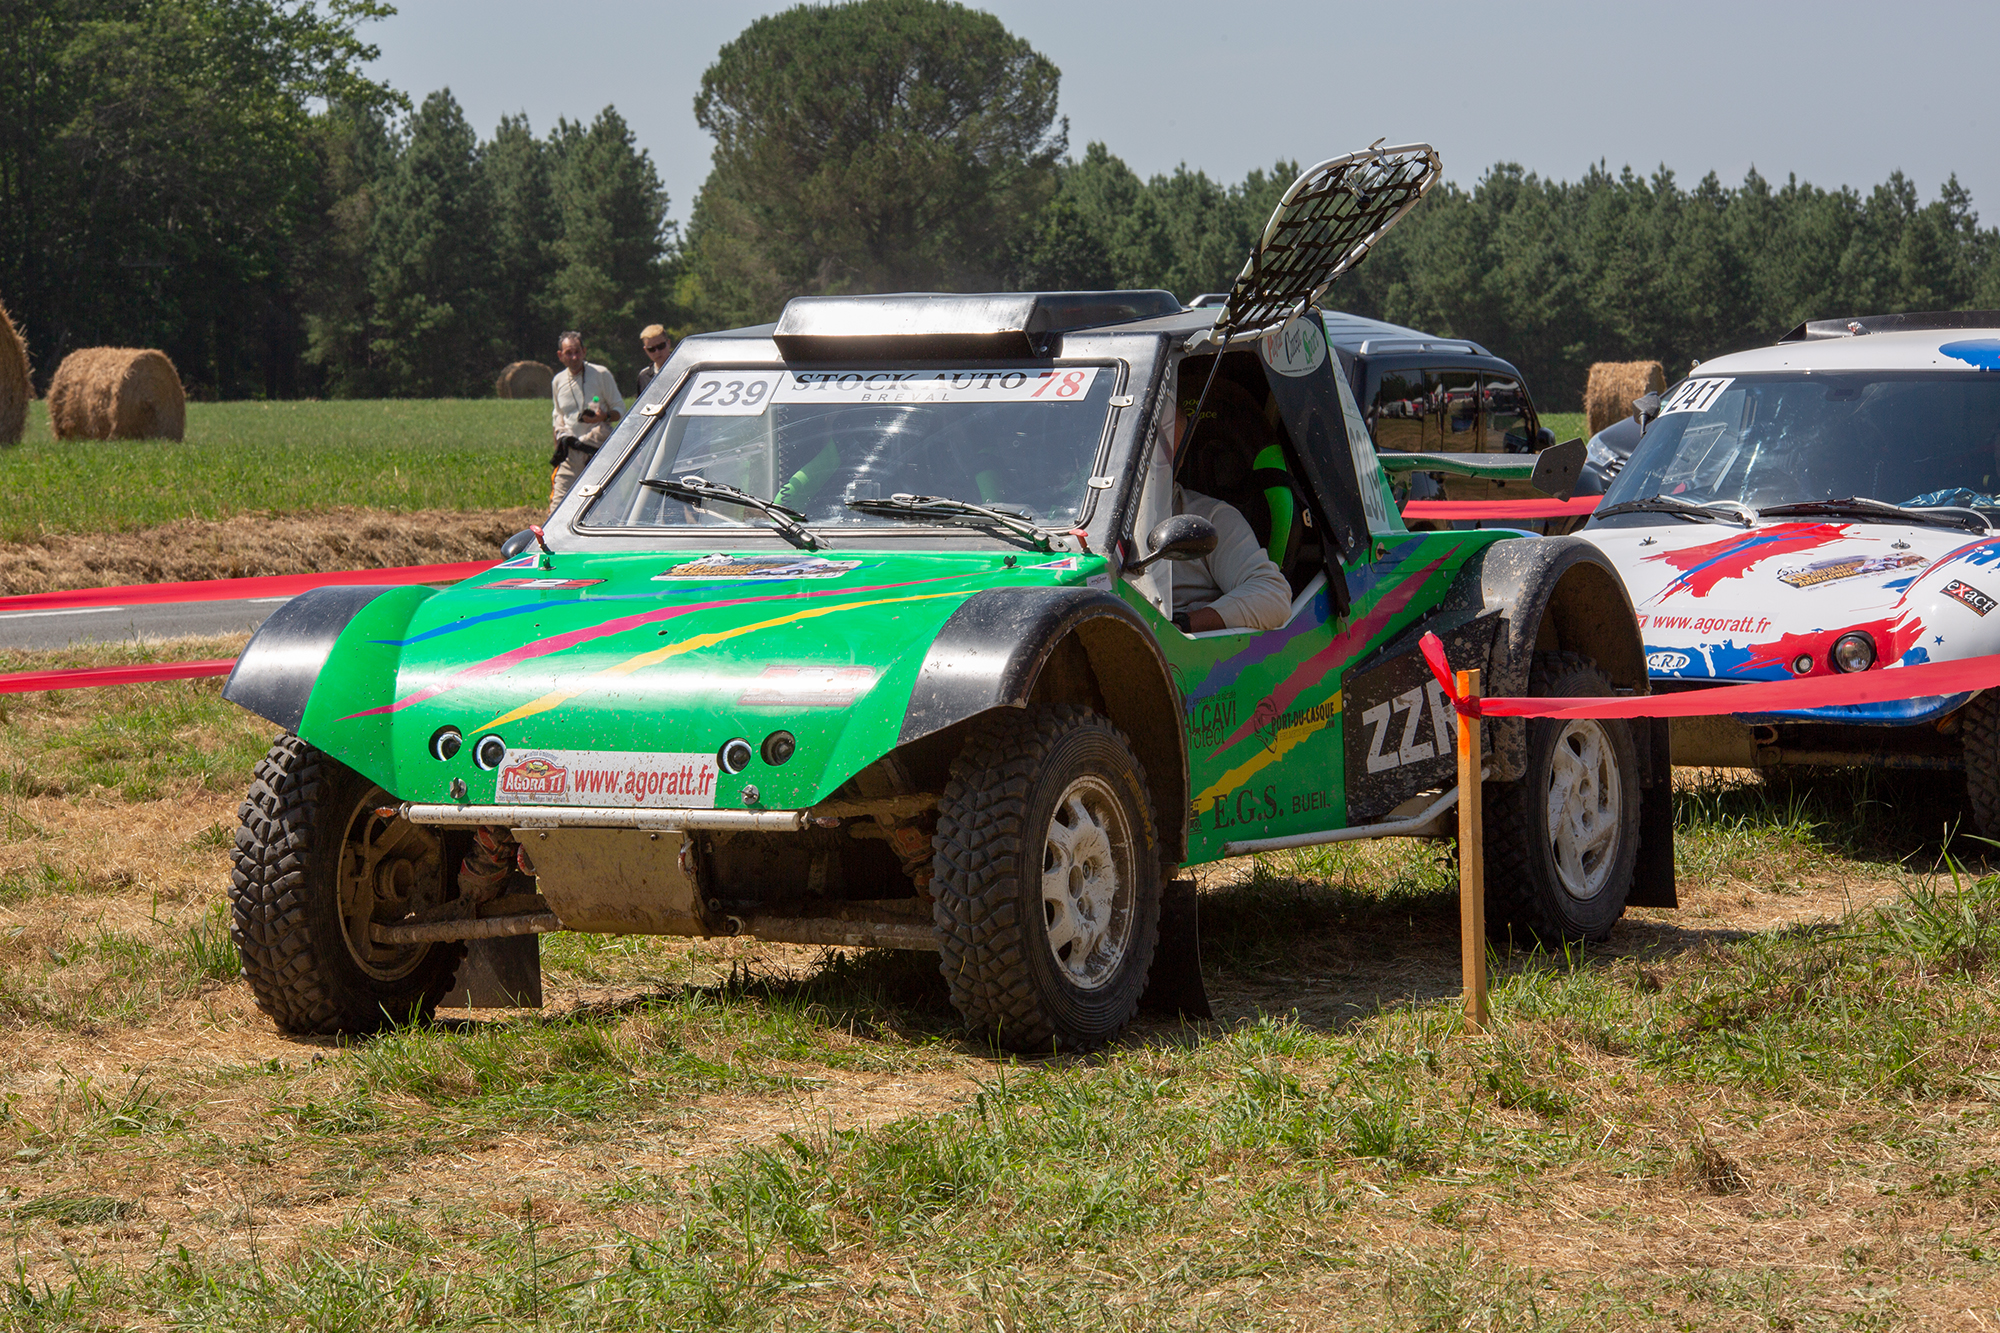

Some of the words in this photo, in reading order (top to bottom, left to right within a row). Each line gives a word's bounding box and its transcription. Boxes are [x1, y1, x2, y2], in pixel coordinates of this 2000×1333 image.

[691, 380, 768, 407] 239
[792, 373, 918, 391] STOCK
[921, 372, 1028, 391] AUTO
[1030, 371, 1086, 398] 78
[861, 393, 950, 402] BREVAL
[1666, 380, 1726, 413] 241
[1122, 484, 1140, 540] Ludovic
[1136, 380, 1167, 482] LEMARCHAND
[1652, 616, 1771, 634] www.agoratt.fr
[1648, 654, 1687, 668] C.R.D
[1271, 702, 1335, 736] PORT-DU-CASQUE
[1189, 724, 1225, 750] rotect
[505, 771, 546, 791] AGORA
[550, 772, 565, 791] TT
[574, 765, 714, 801] www.agoratt.fr
[1212, 785, 1284, 830] E.G.S.
[1292, 791, 1330, 814] BUEIL
